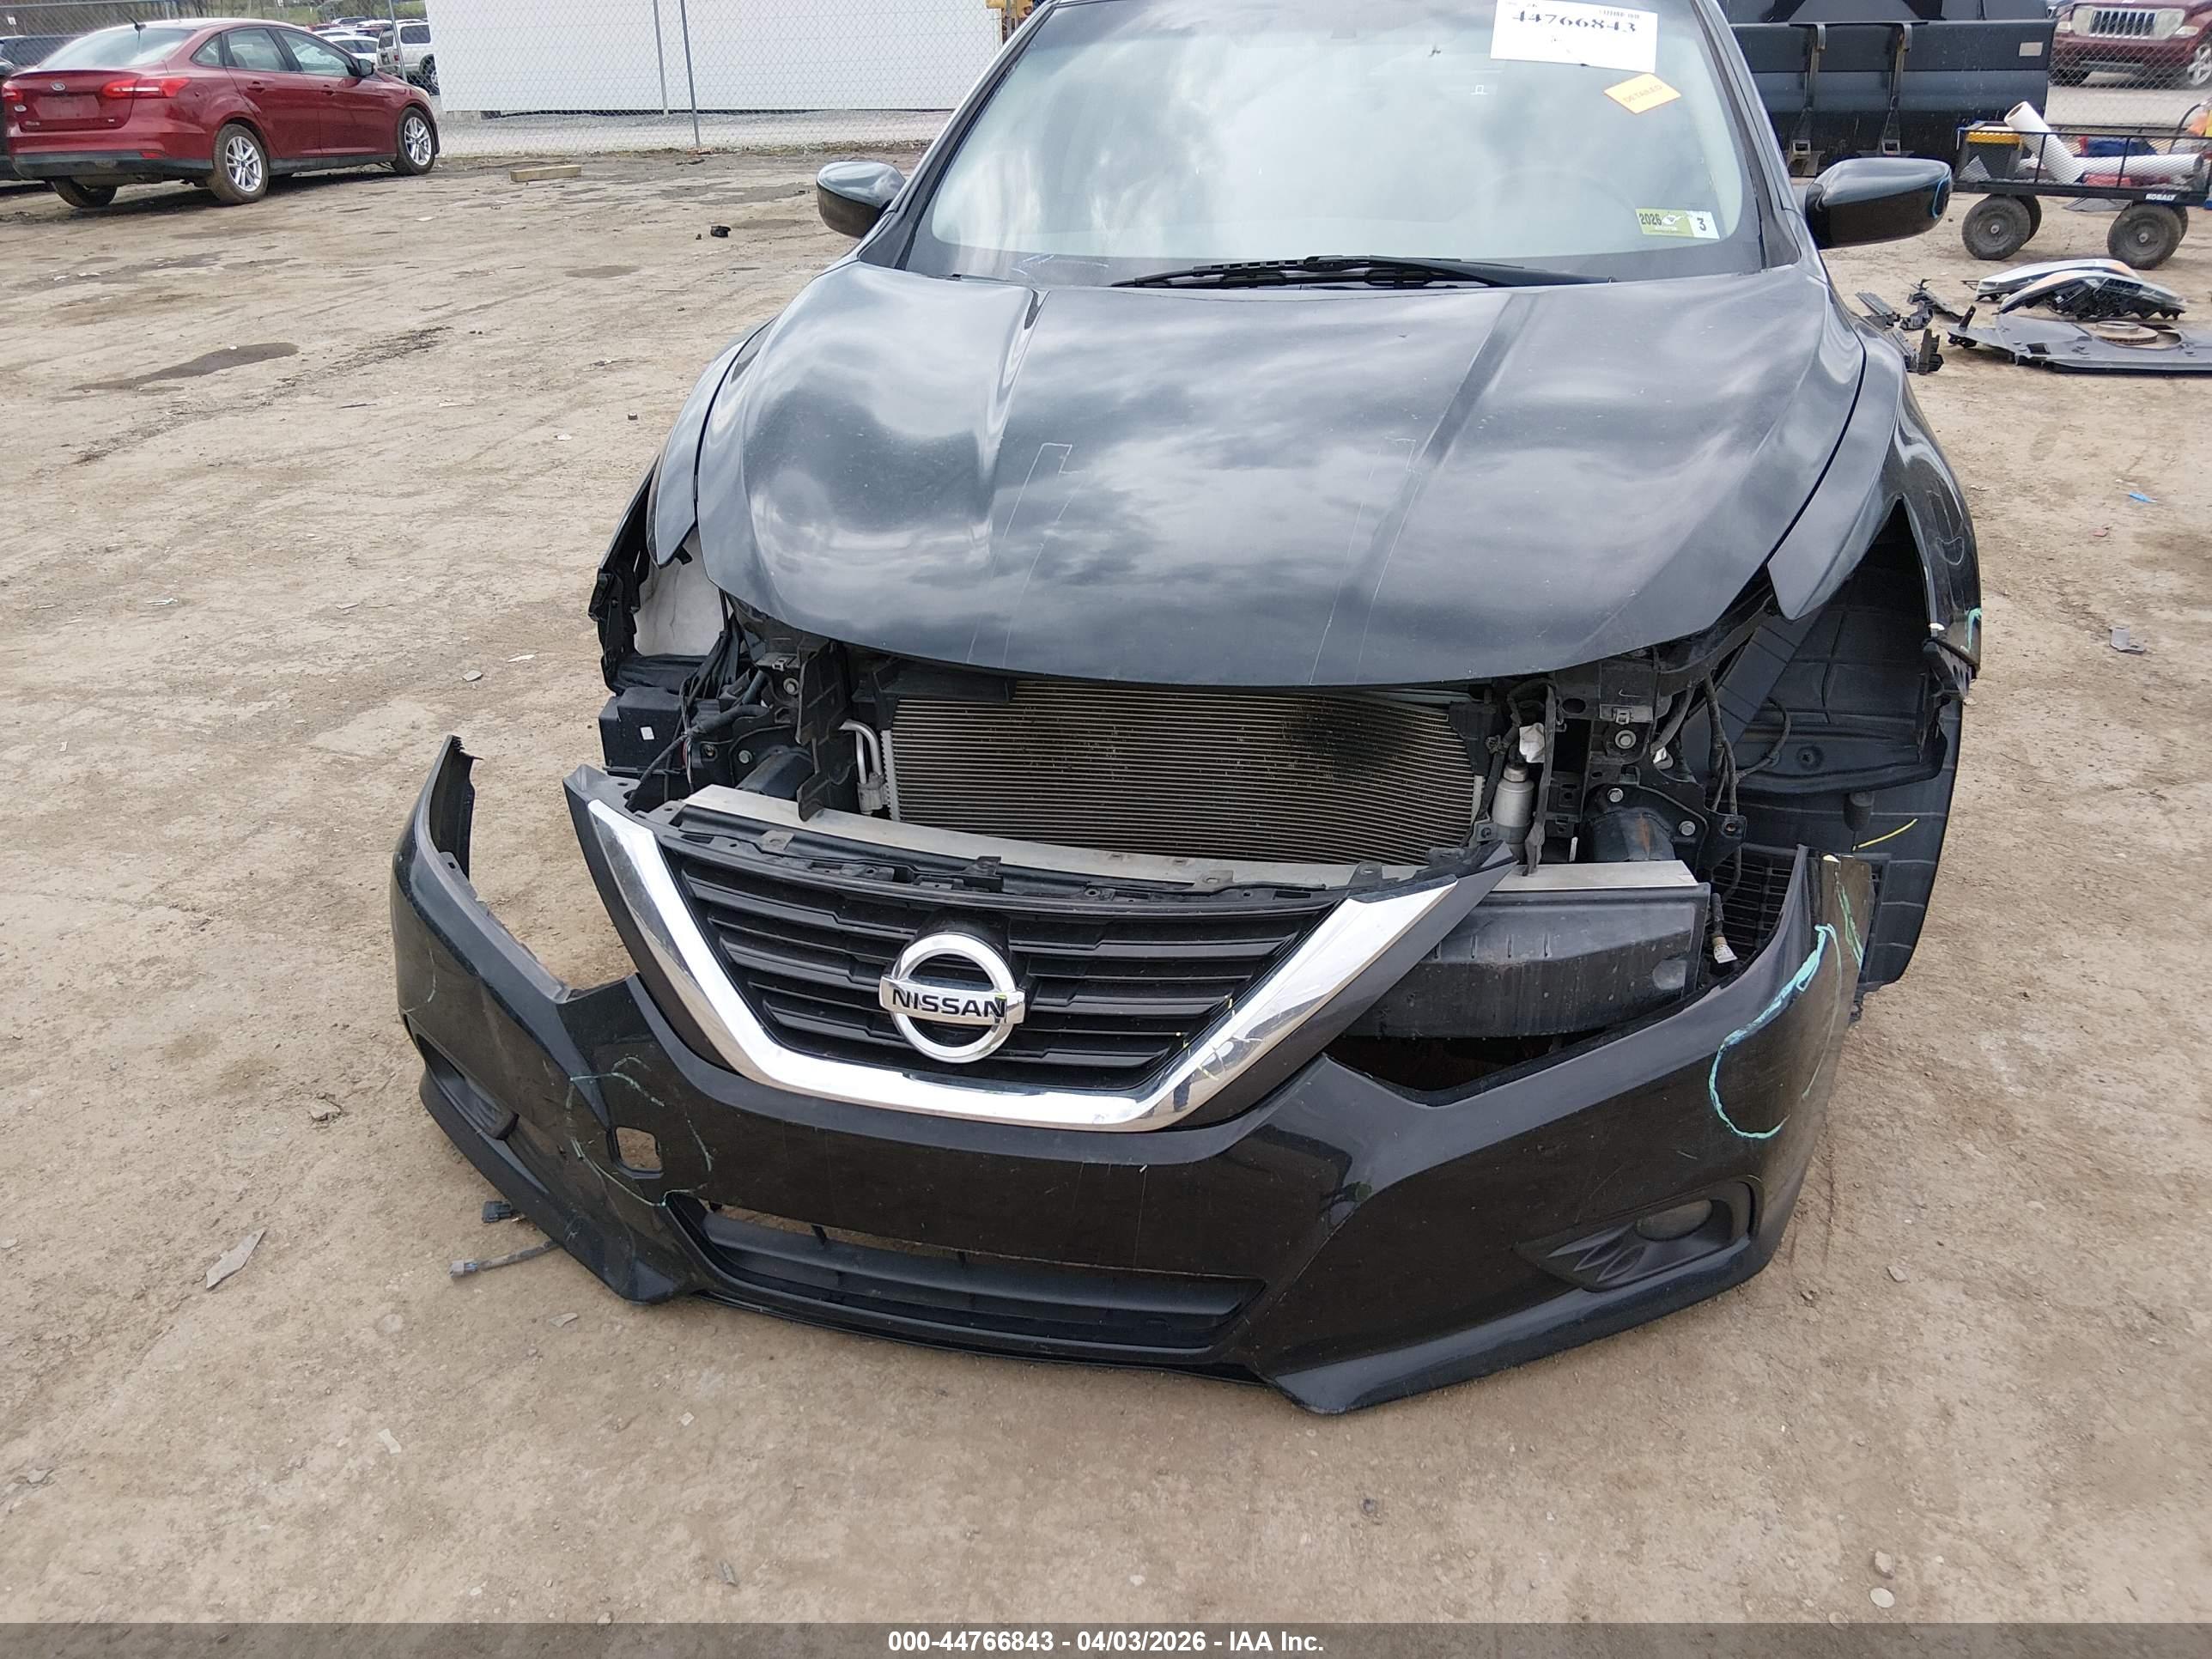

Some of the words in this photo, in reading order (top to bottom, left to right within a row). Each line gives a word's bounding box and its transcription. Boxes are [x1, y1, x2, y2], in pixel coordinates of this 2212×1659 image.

[1512, 9, 1637, 33] 44766843
[1638, 213, 1662, 226] 2026
[1696, 217, 1707, 232] 3
[892, 988, 1007, 1019] NISSAN
